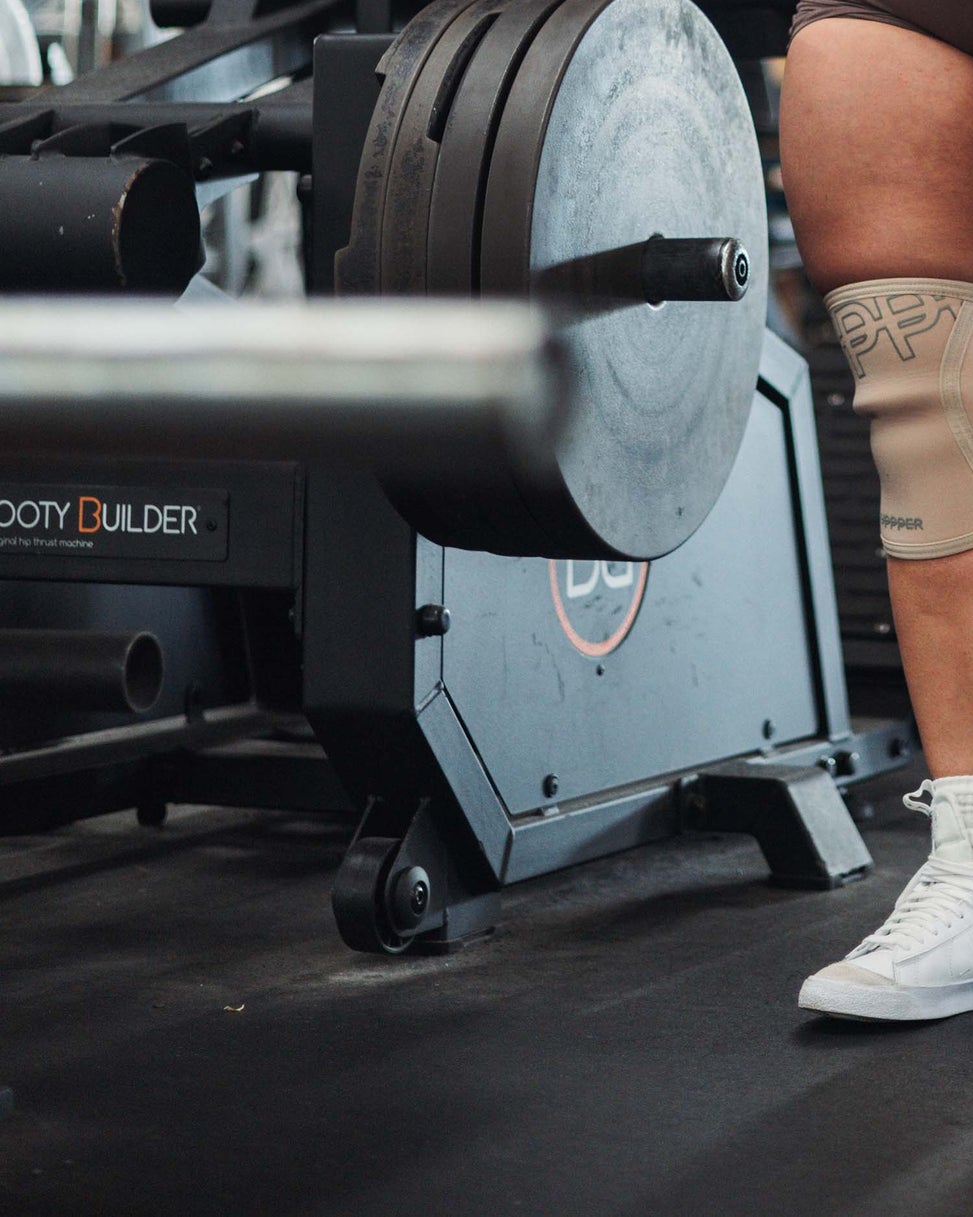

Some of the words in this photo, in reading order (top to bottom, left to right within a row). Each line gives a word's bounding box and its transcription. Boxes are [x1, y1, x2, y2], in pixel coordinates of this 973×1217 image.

[78, 496, 197, 534] BUILDER
[19, 537, 31, 547] hip
[33, 537, 57, 547] thrust
[59, 539, 94, 548] machine
